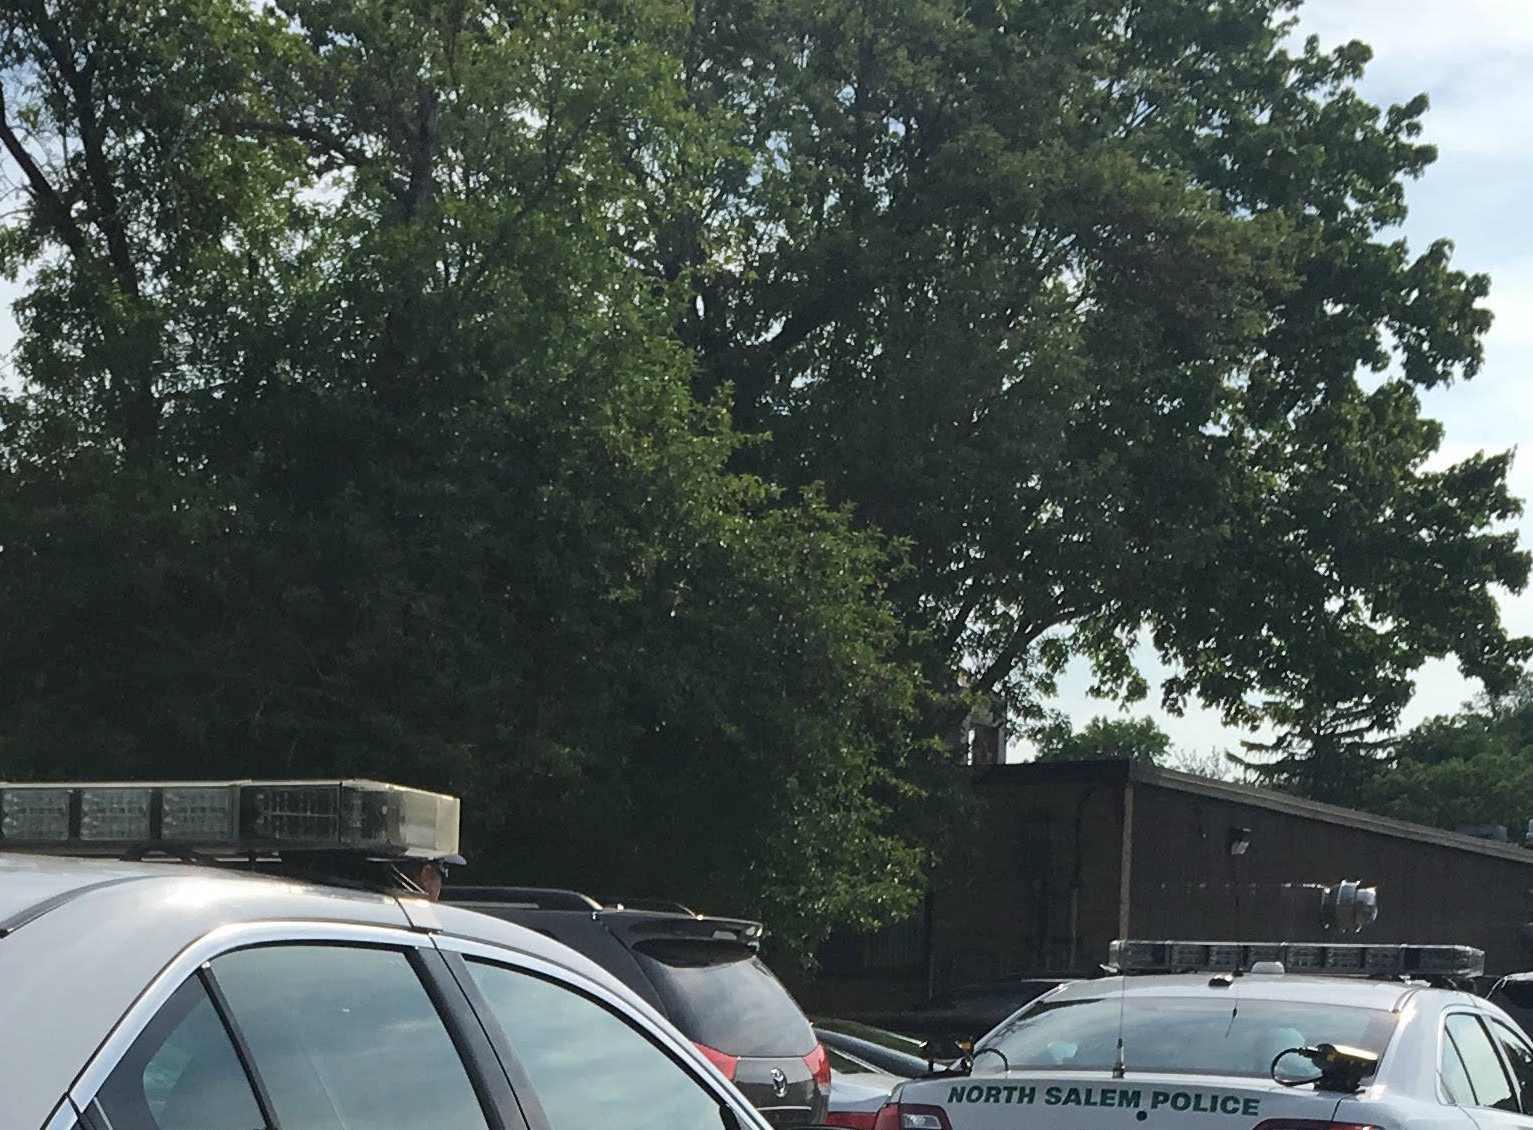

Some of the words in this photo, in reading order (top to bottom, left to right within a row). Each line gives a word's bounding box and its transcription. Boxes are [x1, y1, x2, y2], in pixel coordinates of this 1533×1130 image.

[947, 1085, 1036, 1105] NORTH
[1044, 1086, 1142, 1108] SALEM
[1150, 1091, 1261, 1117] POLICE
